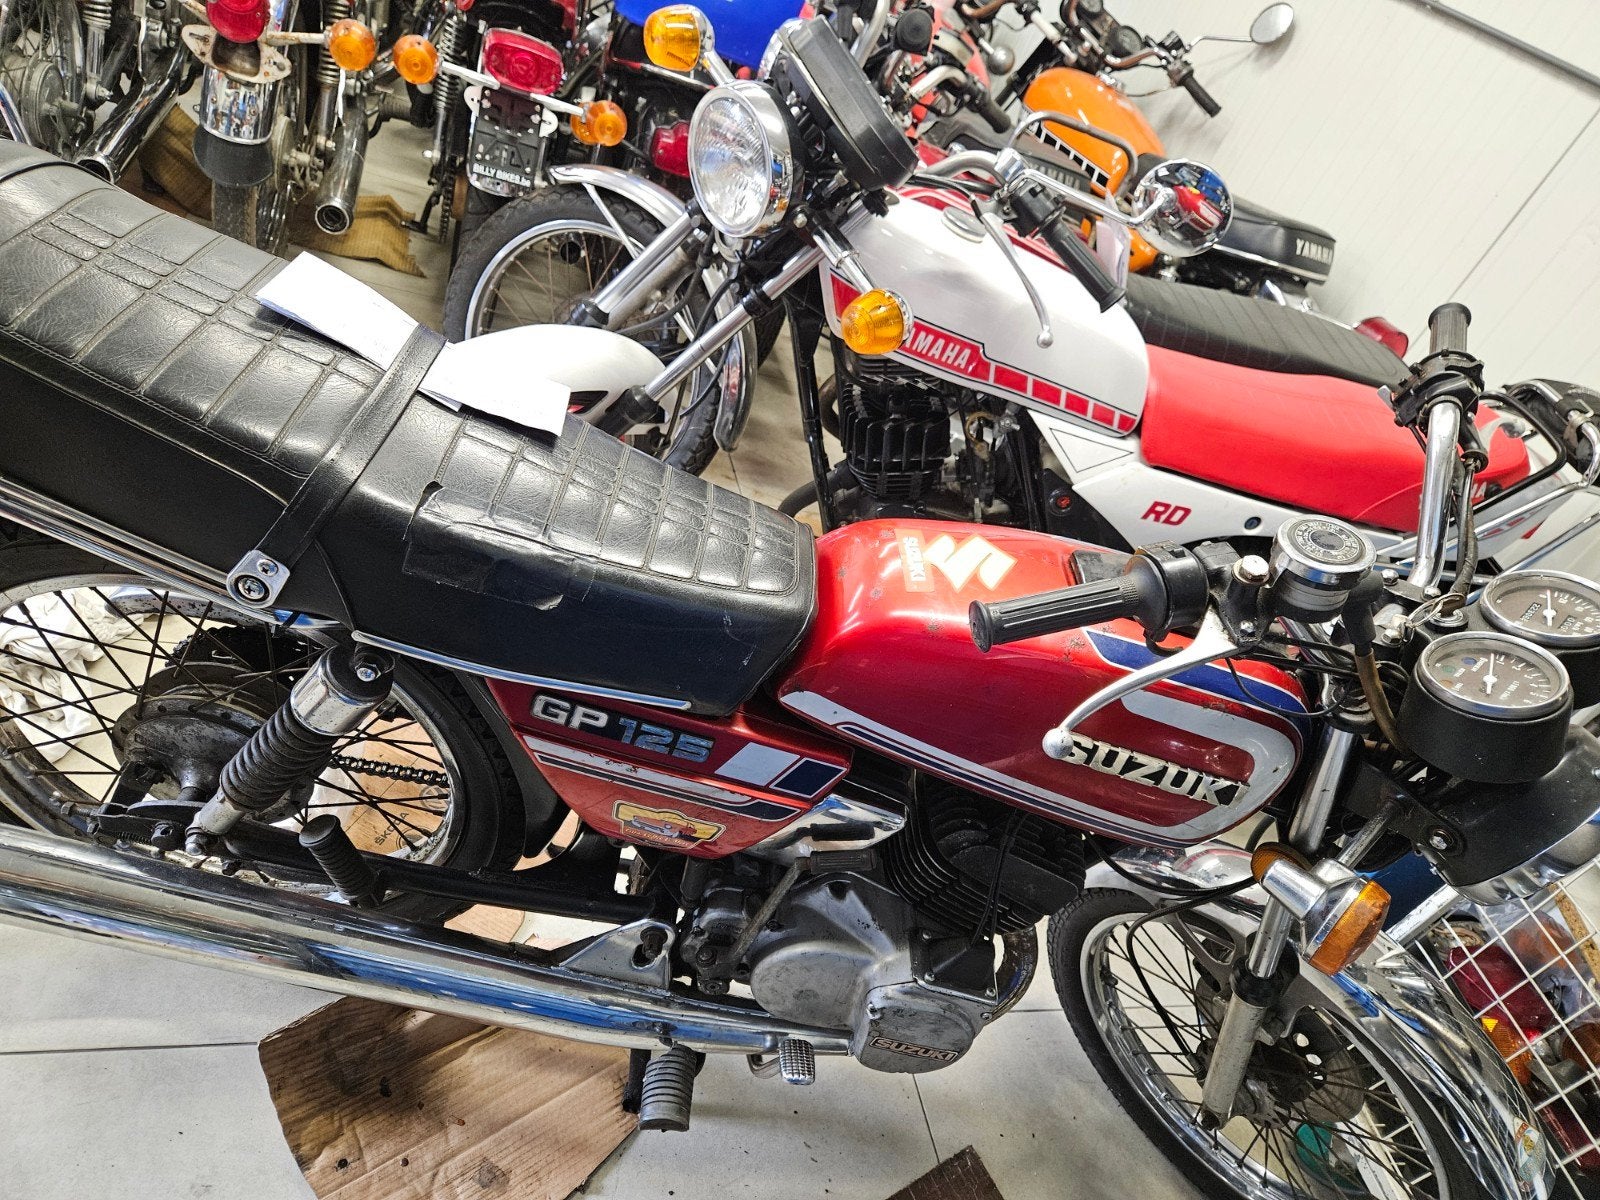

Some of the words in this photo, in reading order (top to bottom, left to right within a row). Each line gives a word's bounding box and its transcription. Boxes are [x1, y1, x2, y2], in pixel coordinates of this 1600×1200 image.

[473, 162, 496, 178] BILLY
[905, 327, 971, 370] MAHA
[1140, 500, 1192, 526] RD
[532, 694, 609, 731] GP
[618, 716, 714, 763] 125
[1062, 732, 1250, 808] SUZUKI
[875, 1038, 955, 1061] SUZUKI
